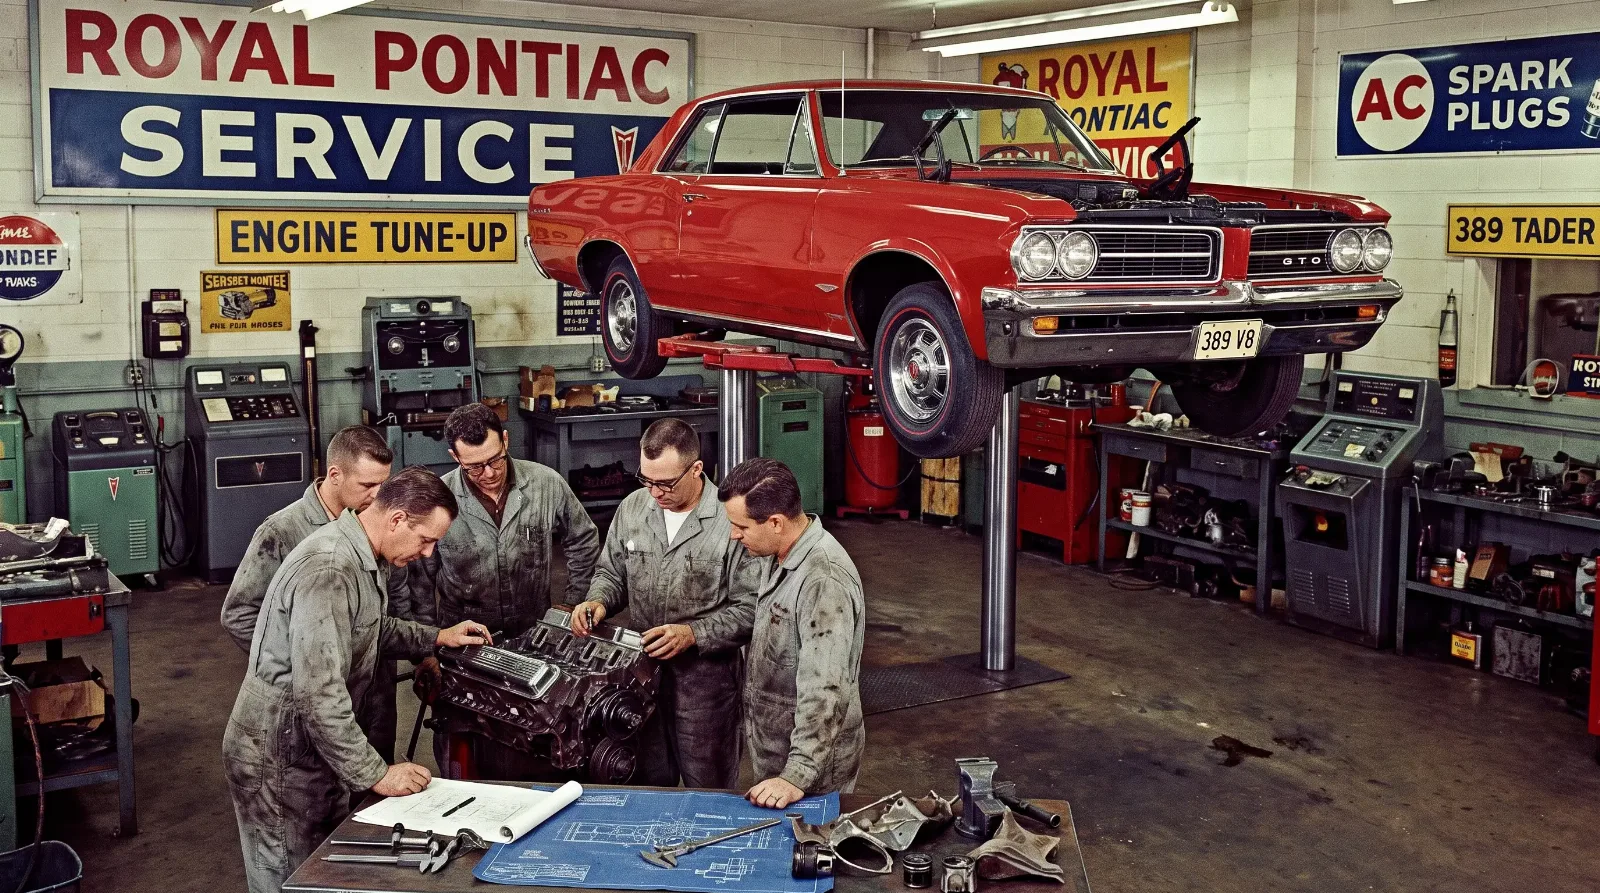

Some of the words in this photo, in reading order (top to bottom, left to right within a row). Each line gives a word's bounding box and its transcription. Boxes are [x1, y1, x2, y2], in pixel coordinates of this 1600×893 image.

[65, 8, 335, 88] ROYAL
[374, 30, 671, 105] PONTIAC
[1038, 46, 1168, 100] ROYAL
[1448, 57, 1573, 96] SPARK
[1356, 74, 1428, 122] AC
[1447, 95, 1571, 132] PLUGS
[1043, 101, 1173, 135] ONTIAC
[119, 105, 575, 184] SERVICE
[230, 219, 358, 254] ENGINE
[370, 221, 508, 254] TUNE-UP
[1455, 216, 1504, 243] 389
[1511, 217, 1596, 245] TADER
[1282, 256, 1321, 266] GTO
[1201, 330, 1232, 351] 389
[1236, 328, 1255, 350] V8
